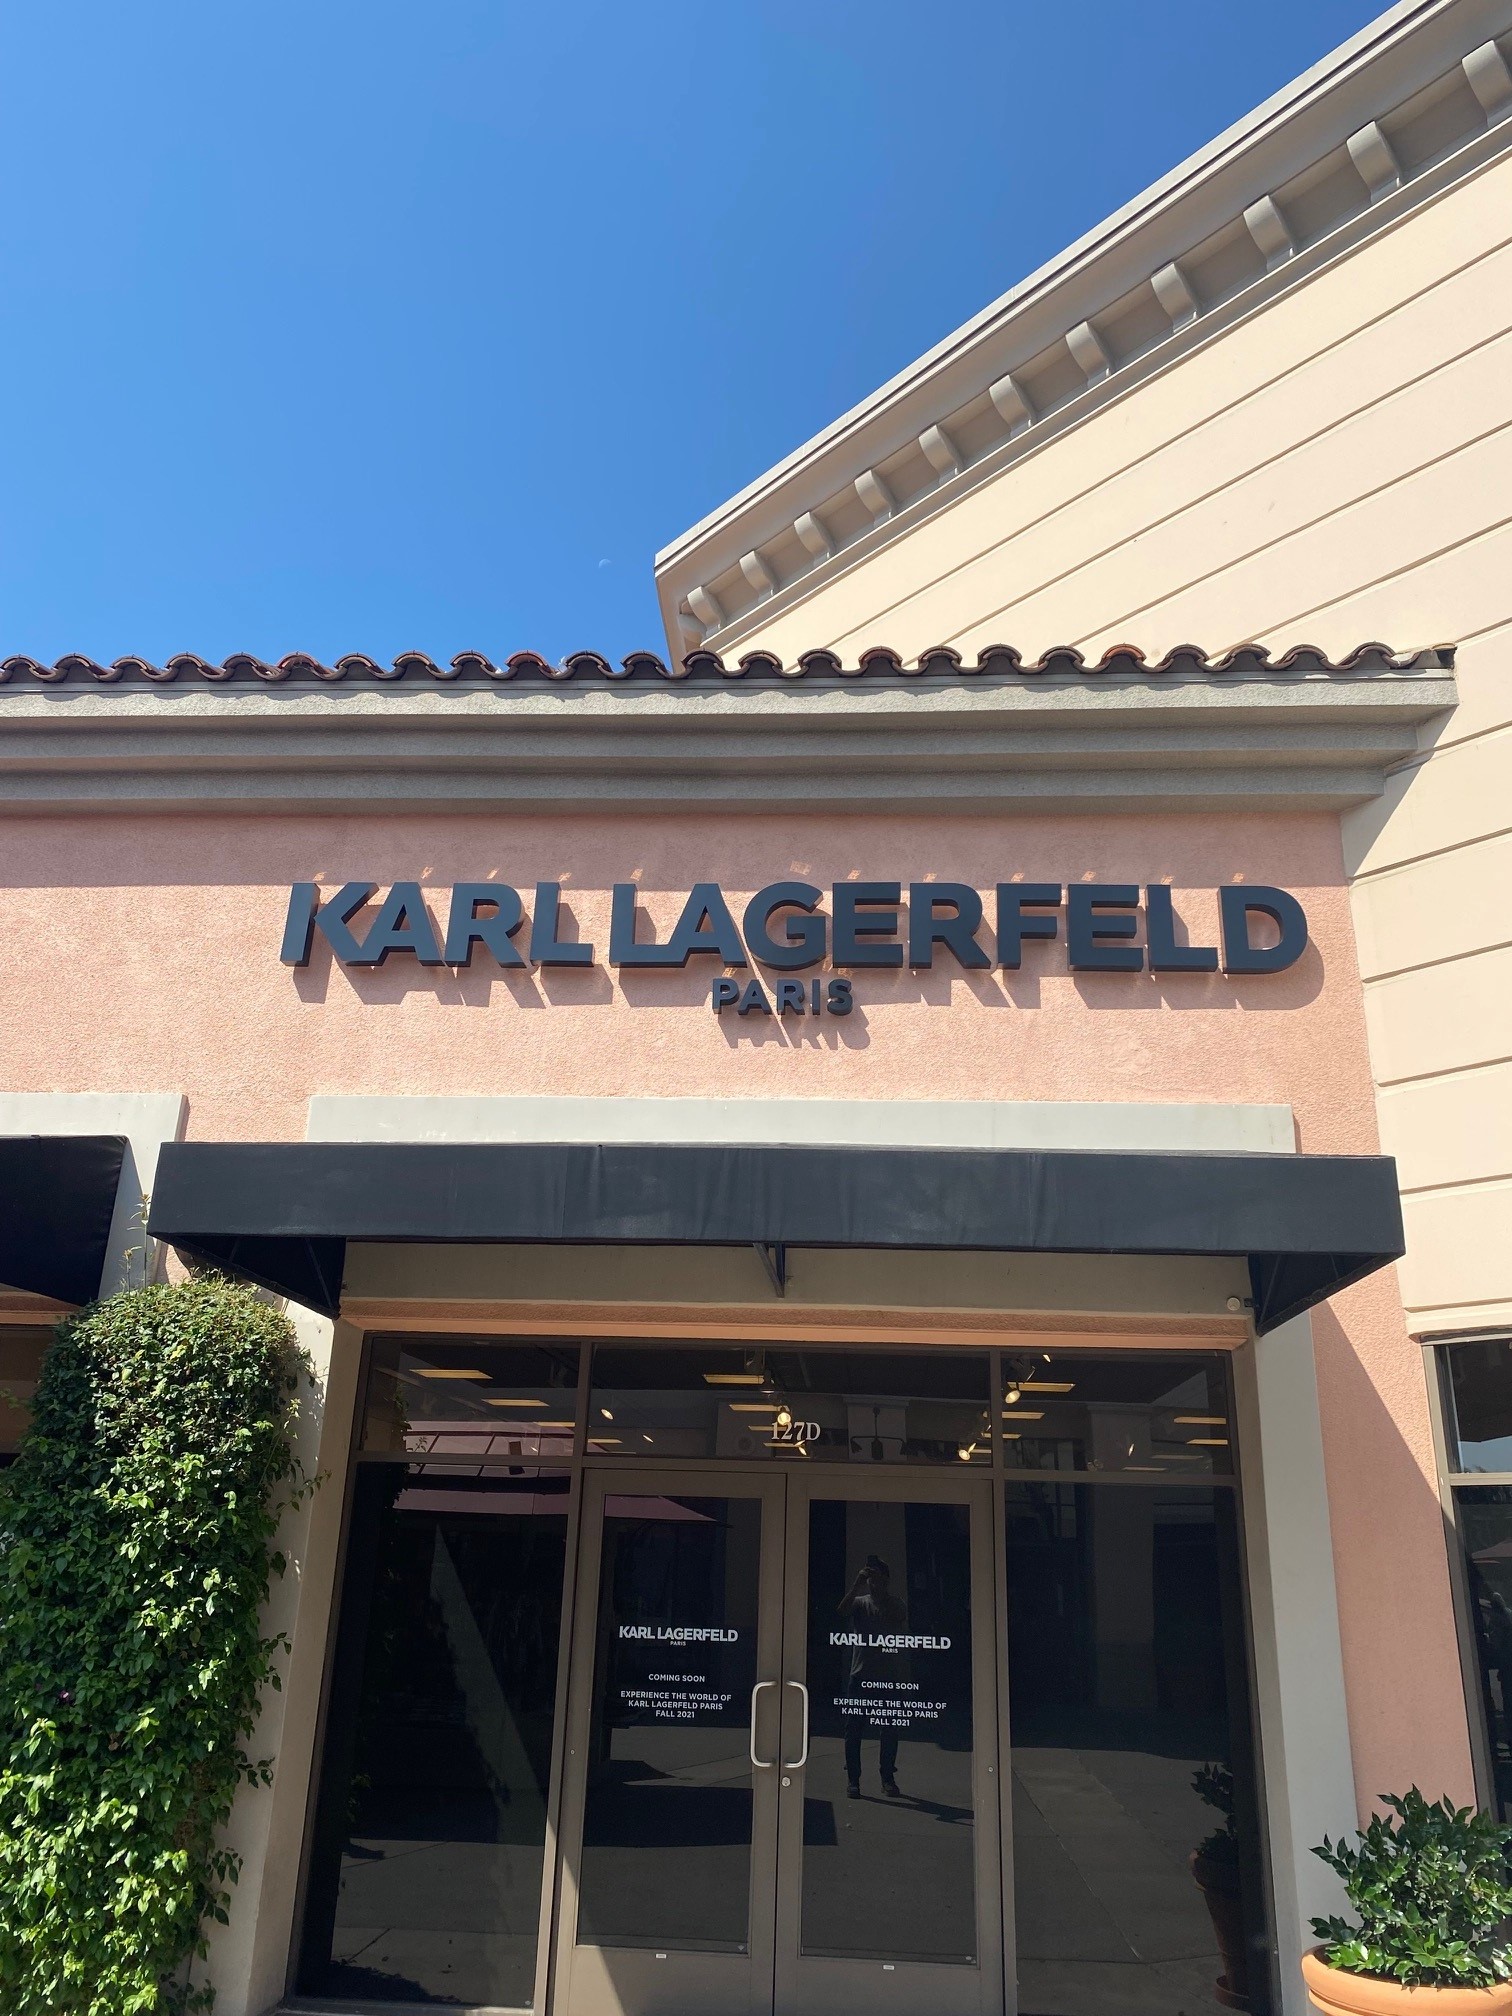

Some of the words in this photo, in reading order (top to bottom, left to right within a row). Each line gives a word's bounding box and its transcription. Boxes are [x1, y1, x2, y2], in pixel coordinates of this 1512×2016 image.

[280, 882, 596, 967] KARL
[609, 881, 1308, 975] LAGERFELD
[712, 977, 854, 1017] PARIS
[771, 1421, 821, 1441] 127D
[619, 1625, 656, 1640] KARL
[657, 1626, 739, 1642] LAGERFELD
[829, 1632, 867, 1647] KARL
[868, 1634, 952, 1650] LAGERFELD
[648, 1673, 680, 1682] COMING
[682, 1674, 706, 1683] SOON
[861, 1681, 894, 1690] COMING
[895, 1682, 919, 1691] SOON
[620, 1690, 670, 1700] EXPERIENCE
[672, 1692, 687, 1700] THE
[688, 1693, 719, 1701] WORLD
[720, 1694, 732, 1702] OF
[628, 1700, 650, 1708] KARL
[651, 1700, 698, 1709] LAGERFELD
[700, 1702, 723, 1710] PARIS
[833, 1698, 884, 1708] EXPERIENCE
[885, 1700, 901, 1708] THE
[902, 1701, 934, 1710] WORLD
[935, 1702, 947, 1710] OF
[655, 1709, 676, 1718] FALL
[676, 1710, 695, 1719] 2021
[841, 1707, 864, 1716] KARL
[865, 1708, 913, 1718] LAGERFELD
[914, 1710, 939, 1719] PARIS
[869, 1717, 890, 1726] FALL
[891, 1718, 910, 1727] 2021
